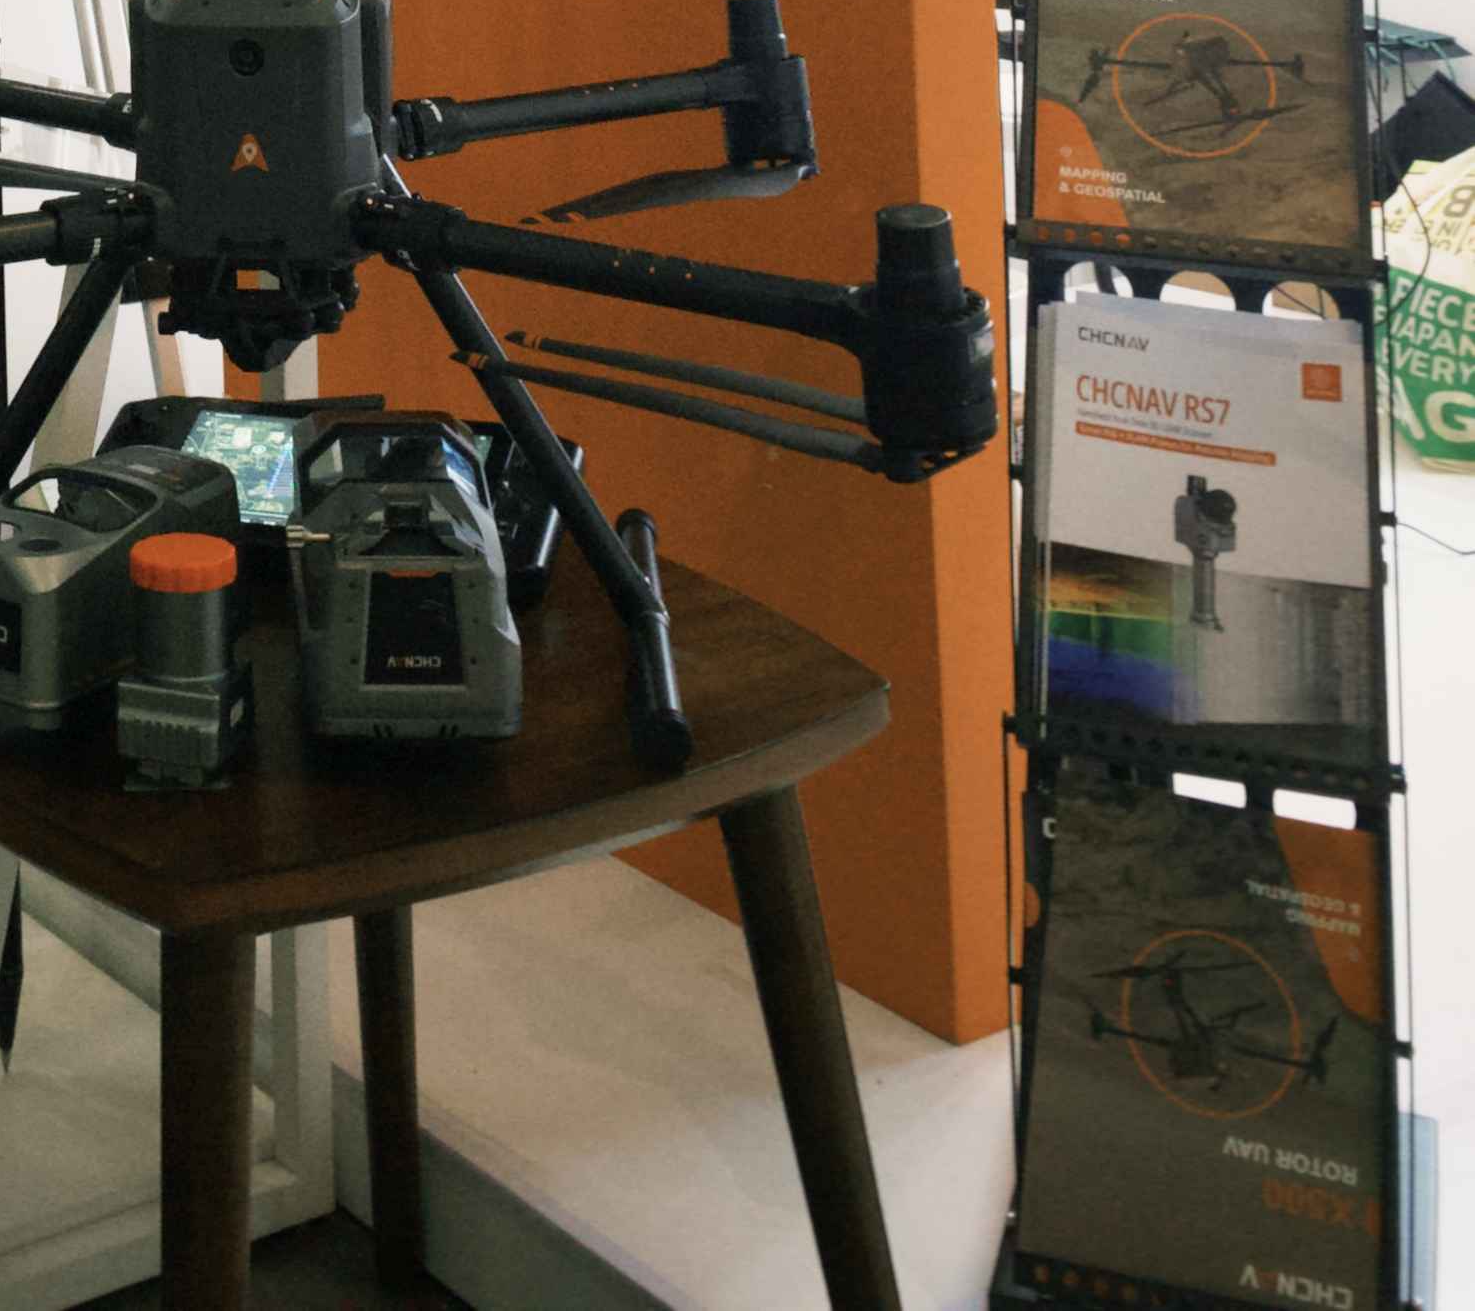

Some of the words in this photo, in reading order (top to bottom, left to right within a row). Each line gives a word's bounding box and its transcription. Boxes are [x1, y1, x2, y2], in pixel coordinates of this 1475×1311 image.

[1059, 165, 1127, 183] MAPPING
[1073, 183, 1166, 204] GEOSPATIAL
[1078, 326, 1149, 352] CHCNAV
[1077, 374, 1178, 418] CHCNAV
[1184, 393, 1231, 427] RS7
[1222, 1136, 1270, 1165] UAV
[1274, 1148, 1359, 1187] ROTOR
